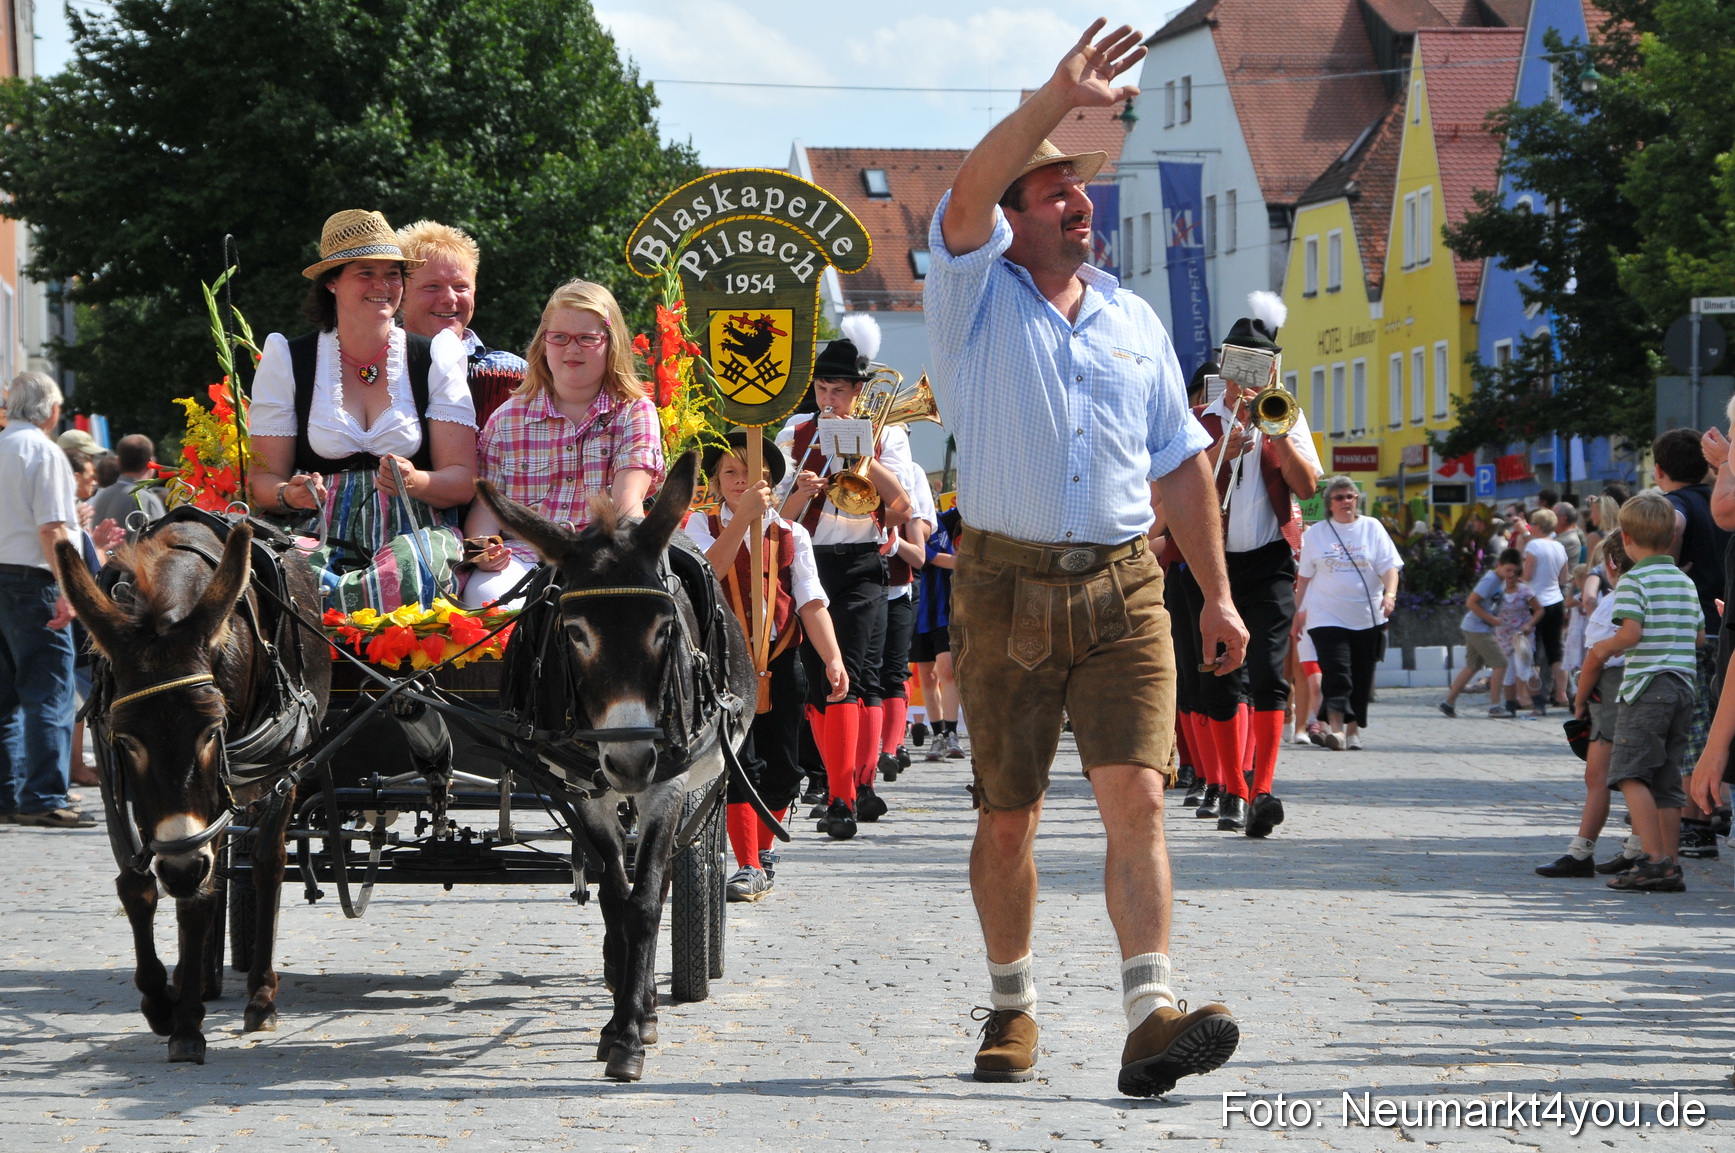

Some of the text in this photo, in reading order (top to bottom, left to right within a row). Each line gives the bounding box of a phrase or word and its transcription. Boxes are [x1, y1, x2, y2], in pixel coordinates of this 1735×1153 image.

[633, 183, 853, 264] Blaskapelle
[680, 230, 815, 284] Pilsach
[725, 274, 776, 294] 1954
[1318, 327, 1343, 356] HOTEL
[1334, 453, 1377, 465] WISSMACH
[1480, 468, 1491, 494] P
